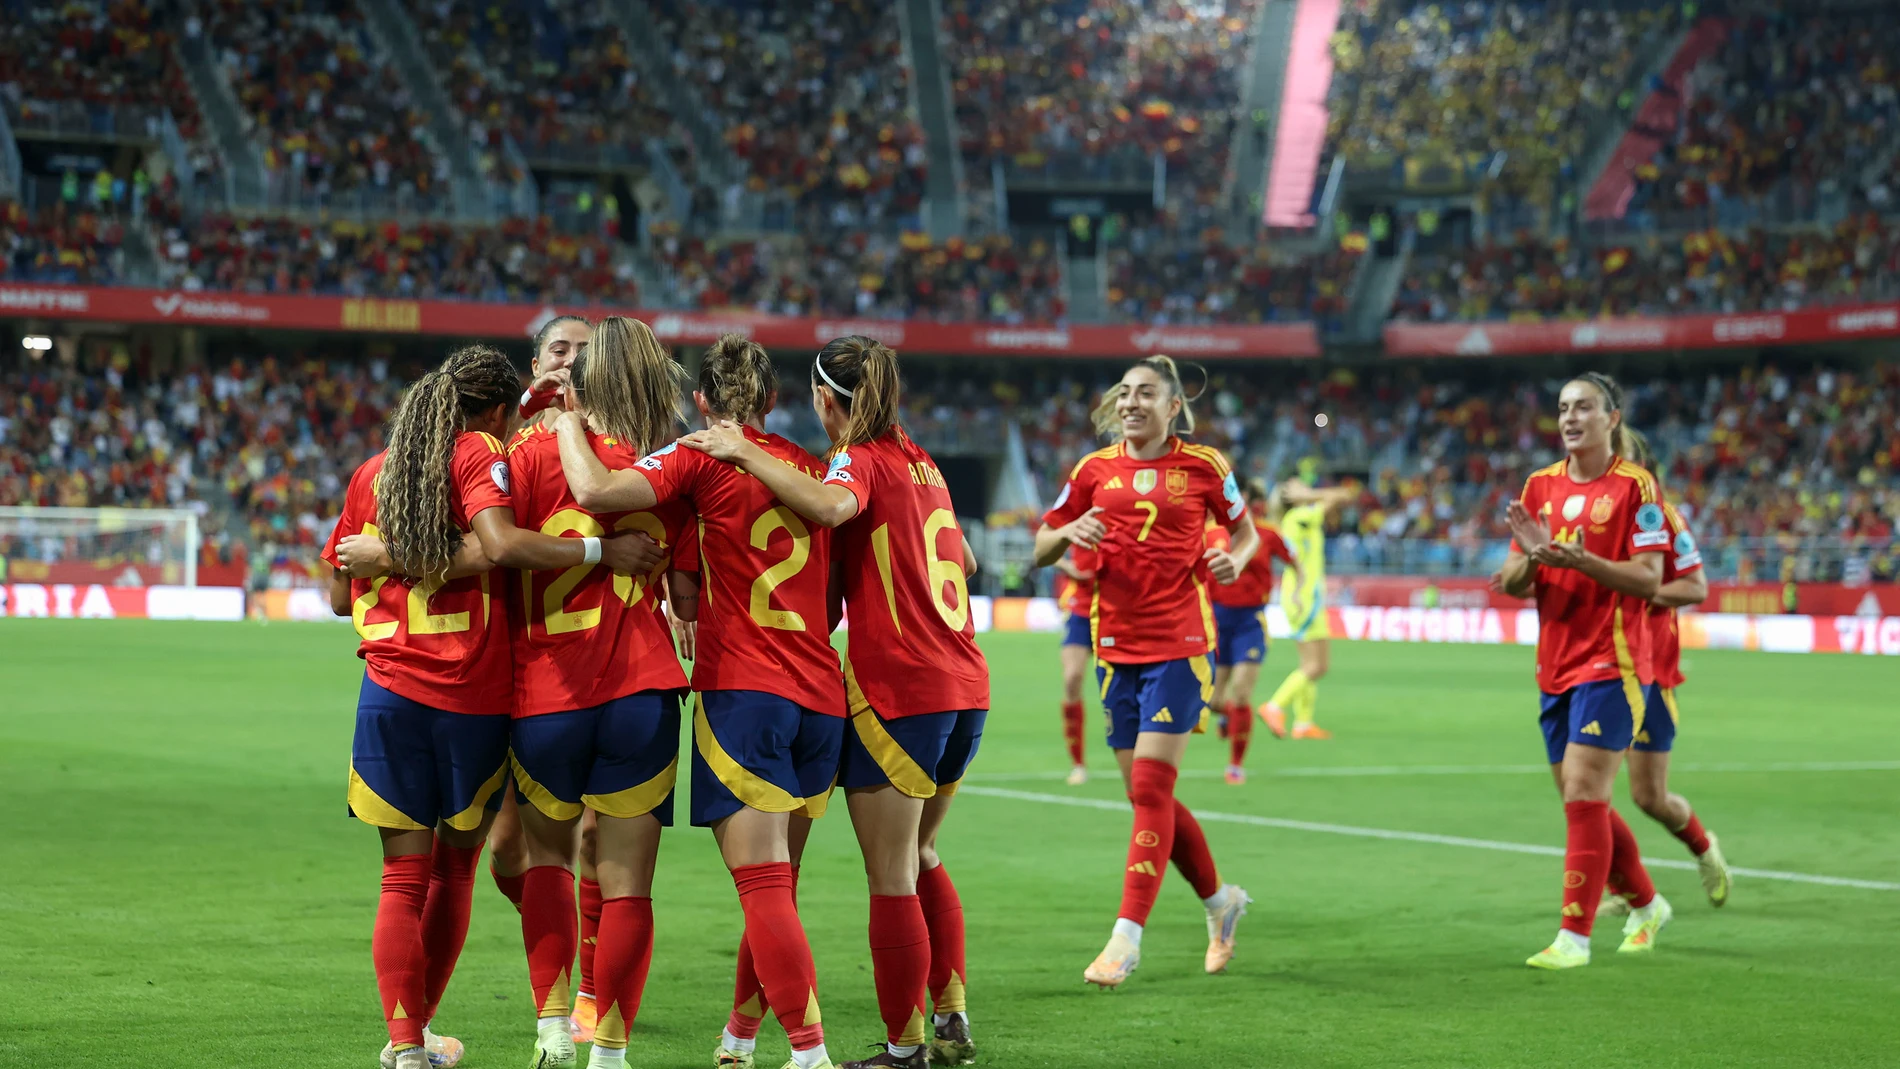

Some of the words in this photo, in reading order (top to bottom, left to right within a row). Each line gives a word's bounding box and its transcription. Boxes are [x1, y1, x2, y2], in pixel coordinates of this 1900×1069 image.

[1134, 500, 1158, 542] 7
[750, 505, 810, 631] 2
[923, 508, 968, 632] 6
[0, 584, 116, 619] RIA
[1340, 605, 1503, 642] VICTORIA
